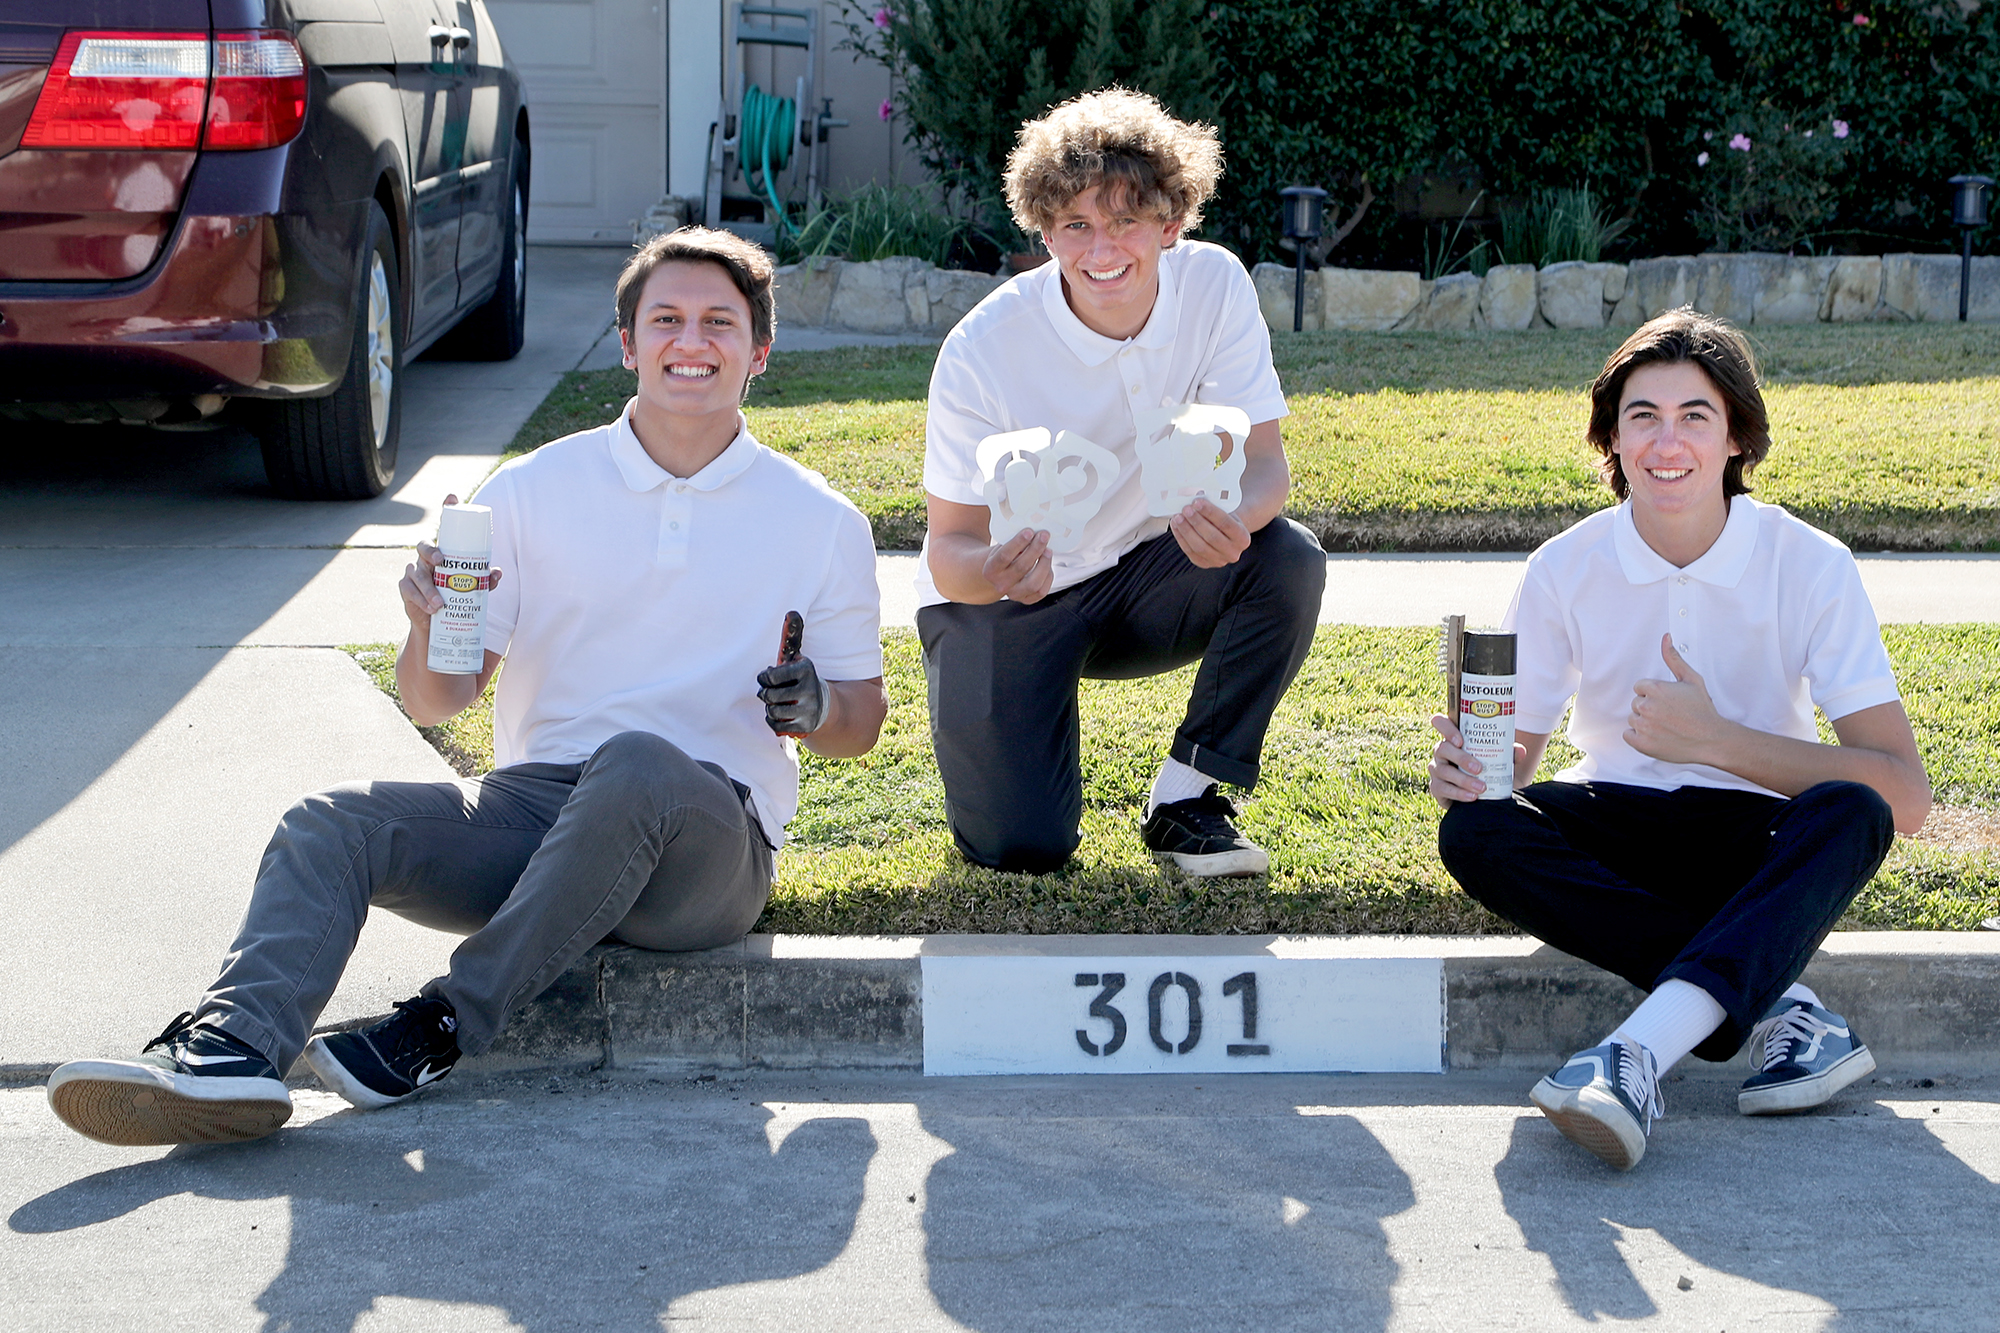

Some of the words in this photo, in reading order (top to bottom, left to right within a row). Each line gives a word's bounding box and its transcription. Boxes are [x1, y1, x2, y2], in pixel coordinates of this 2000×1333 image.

[443, 603, 481, 611] ROTECTIVE
[445, 611, 475, 619] ENAMEL
[1473, 722, 1498, 730] GLOSS
[1464, 729, 1506, 738] PROTECTIVE
[1469, 737, 1500, 745] ENAMEL
[1074, 971, 1271, 1058] 301
